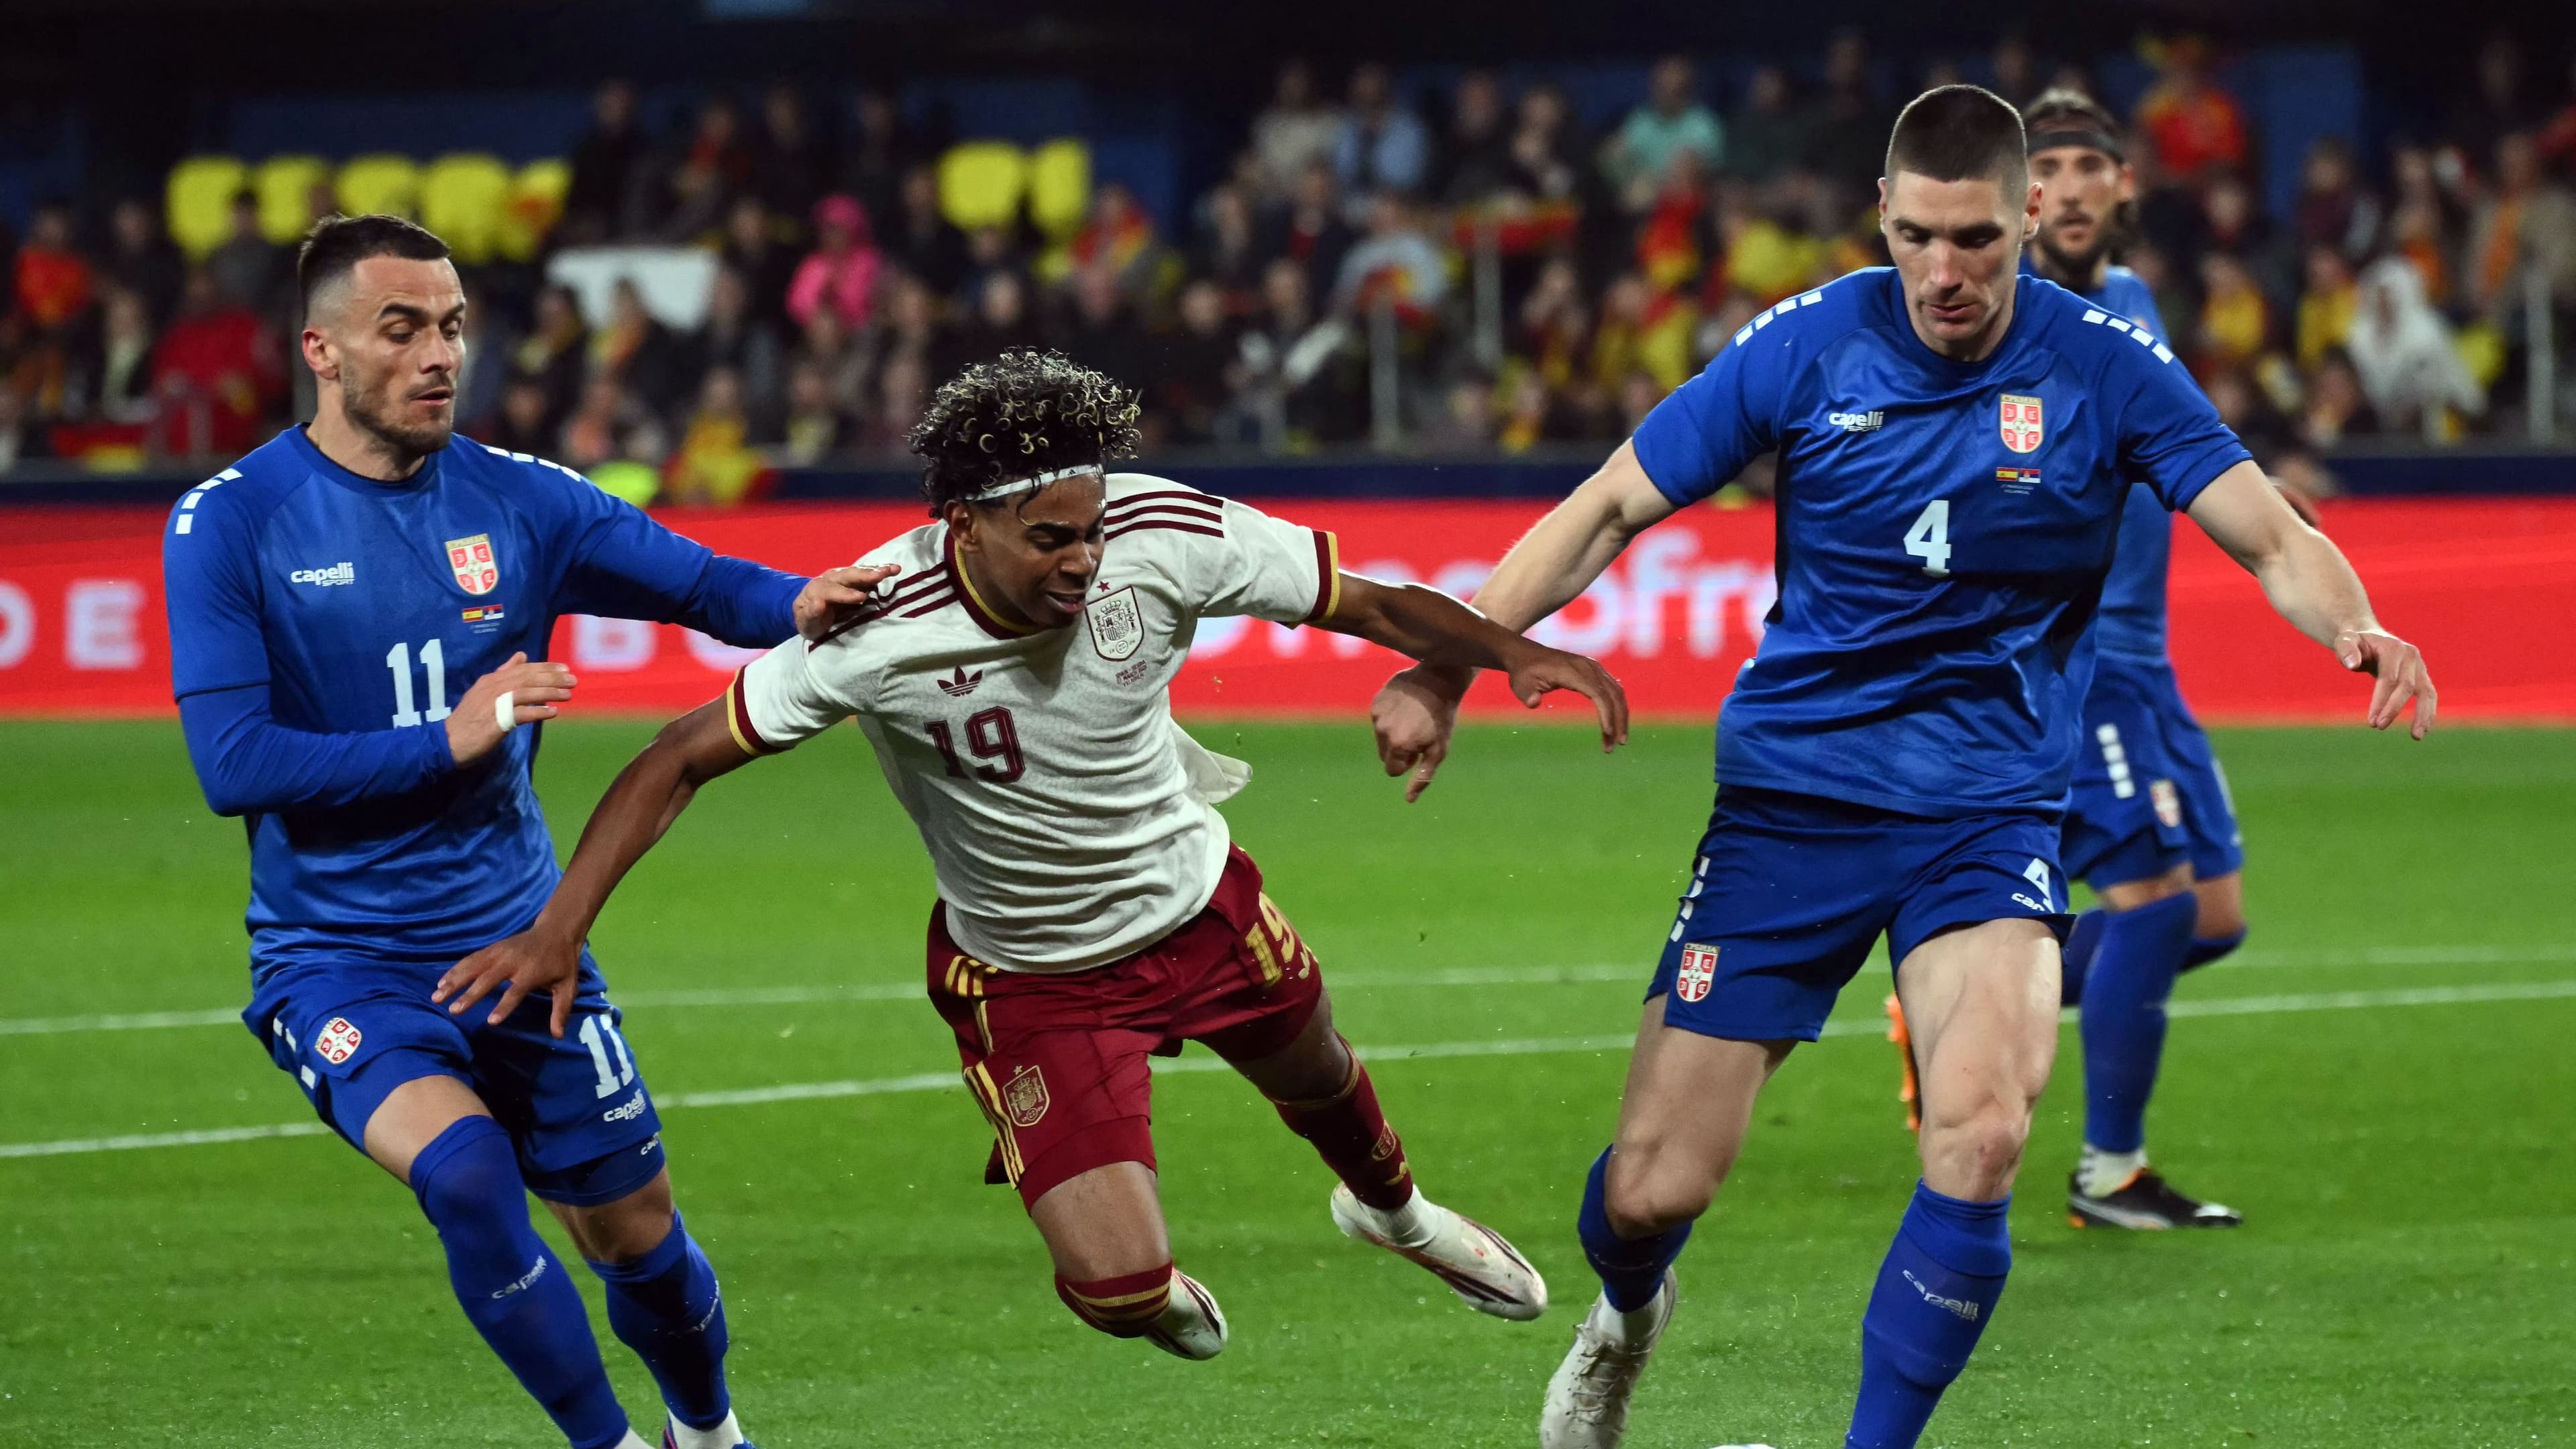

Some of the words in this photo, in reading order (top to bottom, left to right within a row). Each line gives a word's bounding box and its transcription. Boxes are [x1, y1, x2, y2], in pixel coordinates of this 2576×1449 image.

[1829, 411, 1884, 430] capelli
[290, 562, 355, 586] capelli
[1903, 500, 1951, 578] 4
[386, 639, 451, 729] 11
[924, 706, 1026, 784] 19
[1245, 891, 1295, 986] 19
[578, 1007, 635, 1099] 11
